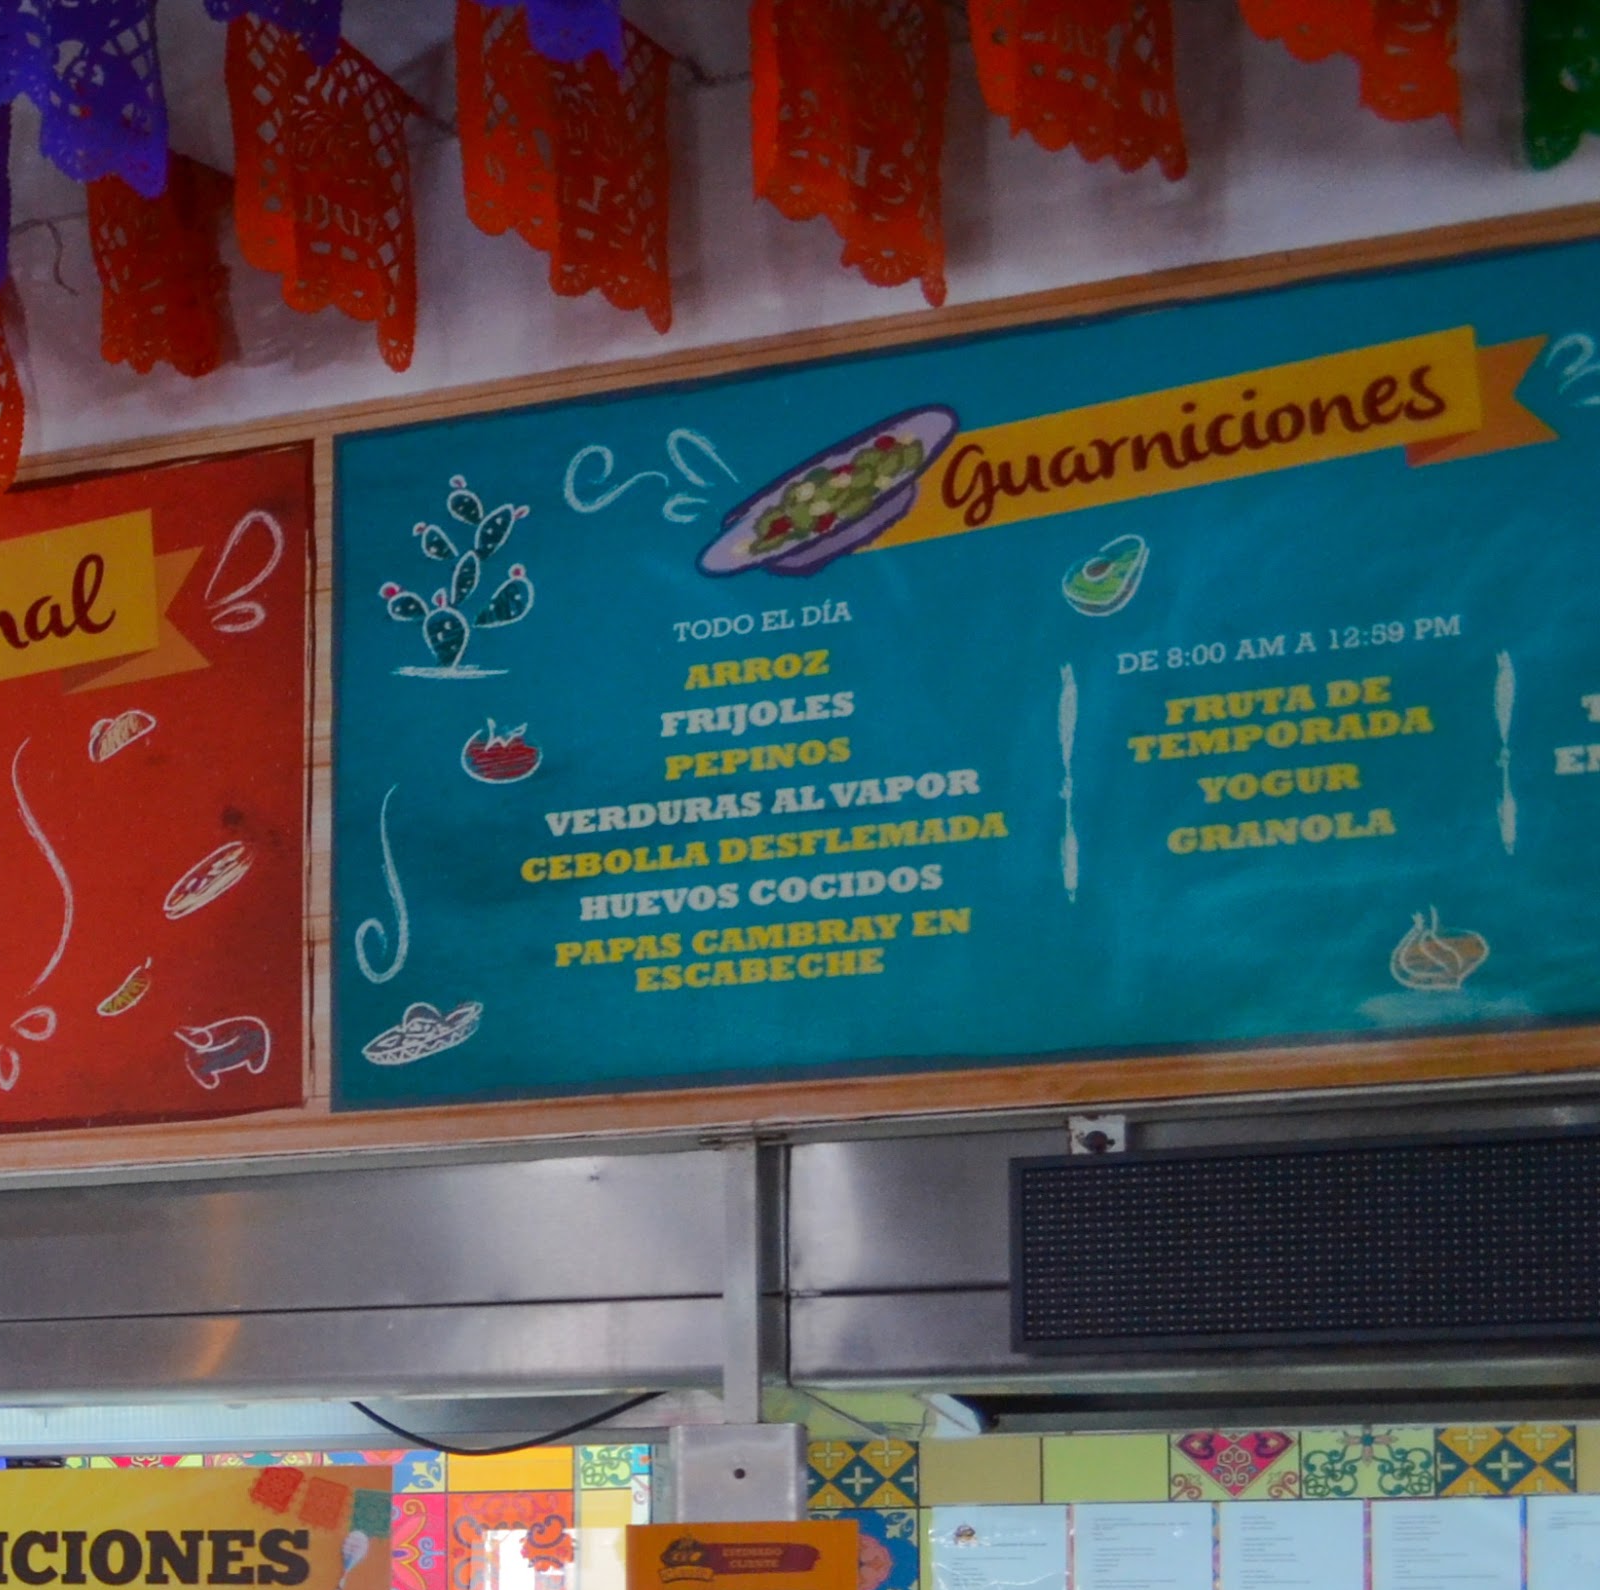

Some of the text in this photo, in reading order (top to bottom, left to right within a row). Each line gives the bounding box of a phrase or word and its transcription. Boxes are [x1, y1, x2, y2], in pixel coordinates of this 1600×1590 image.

[941, 363, 1448, 528] Guarniciones
[673, 599, 853, 644] TODO EL DÍA
[683, 648, 830, 691] ARROZ
[660, 691, 855, 738] FRIJOLES
[1164, 675, 1393, 726] FRUTA DE
[664, 736, 853, 782] PEPINOS
[1128, 706, 1435, 763] TEMPORADA
[546, 769, 981, 837] VERDURAS AL VAPOR
[1197, 762, 1361, 804] YOGUR
[520, 810, 1008, 884] CEBOLLA DESFLEMADA
[1167, 808, 1397, 855] GRANOLA
[579, 863, 944, 923] HUEVOS COCIDOS
[554, 906, 971, 969] PAPAS CAMBRAY EN
[635, 947, 885, 995] ESCABECHE
